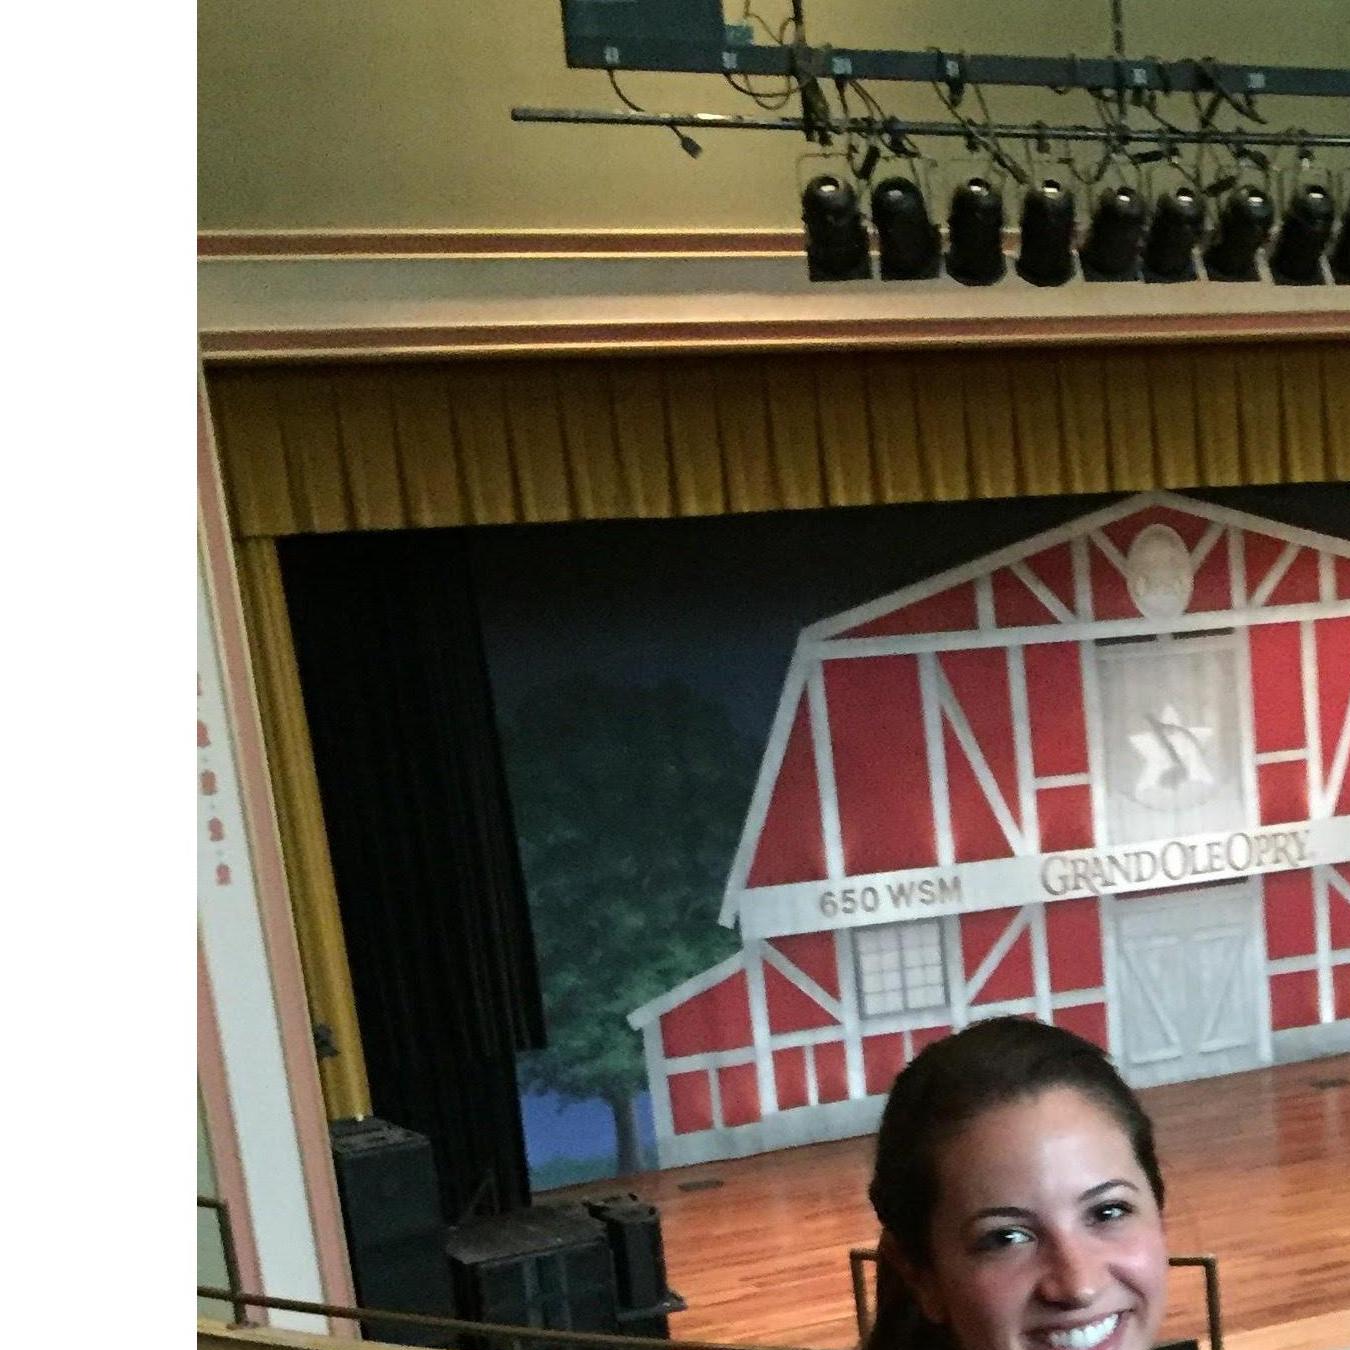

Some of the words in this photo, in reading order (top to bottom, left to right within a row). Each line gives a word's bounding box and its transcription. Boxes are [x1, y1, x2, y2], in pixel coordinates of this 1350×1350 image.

[1041, 850, 1158, 895] GRAND
[1161, 841, 1223, 881] OLE
[1226, 830, 1311, 871] OPRY
[819, 886, 880, 917] 650
[886, 876, 962, 908] WSM
